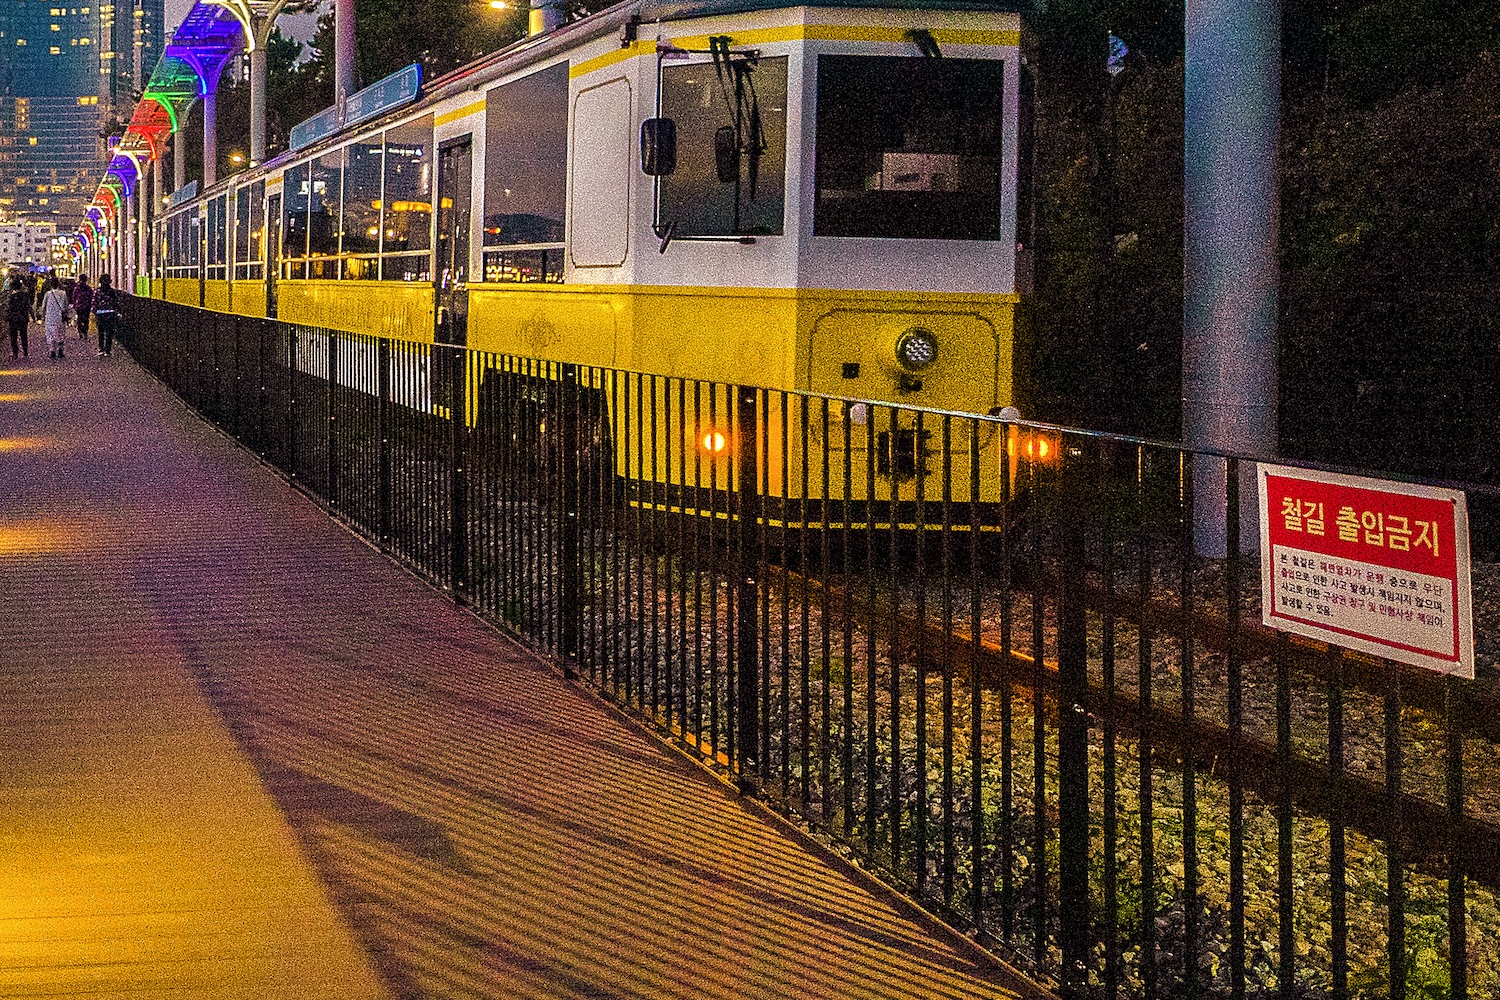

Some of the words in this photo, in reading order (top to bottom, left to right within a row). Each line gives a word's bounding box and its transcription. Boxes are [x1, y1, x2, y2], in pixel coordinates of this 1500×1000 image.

[1280, 496, 1325, 536] 철길
[1336, 506, 1439, 557] 출입금지
[1281, 553, 1287, 564] 본
[1292, 555, 1315, 570] 철길은
[1366, 571, 1384, 585] 운행
[1389, 576, 1418, 590] 중으로
[1423, 583, 1444, 597] 무단
[1281, 567, 1309, 581] 출입으로
[1313, 574, 1328, 587] 인한
[1331, 578, 1347, 591] 사고
[1349, 582, 1375, 598] 발생시
[1379, 588, 1412, 606] 책임지지
[1281, 595, 1303, 610] 발생할
[1305, 602, 1313, 612] 수
[1281, 582, 1303, 595] 사고로
[1306, 587, 1321, 600] 인한
[1323, 591, 1347, 606] 구상권
[1349, 597, 1365, 609] 청구
[1368, 601, 1376, 613] 및
[1417, 612, 1444, 628] 책임이
